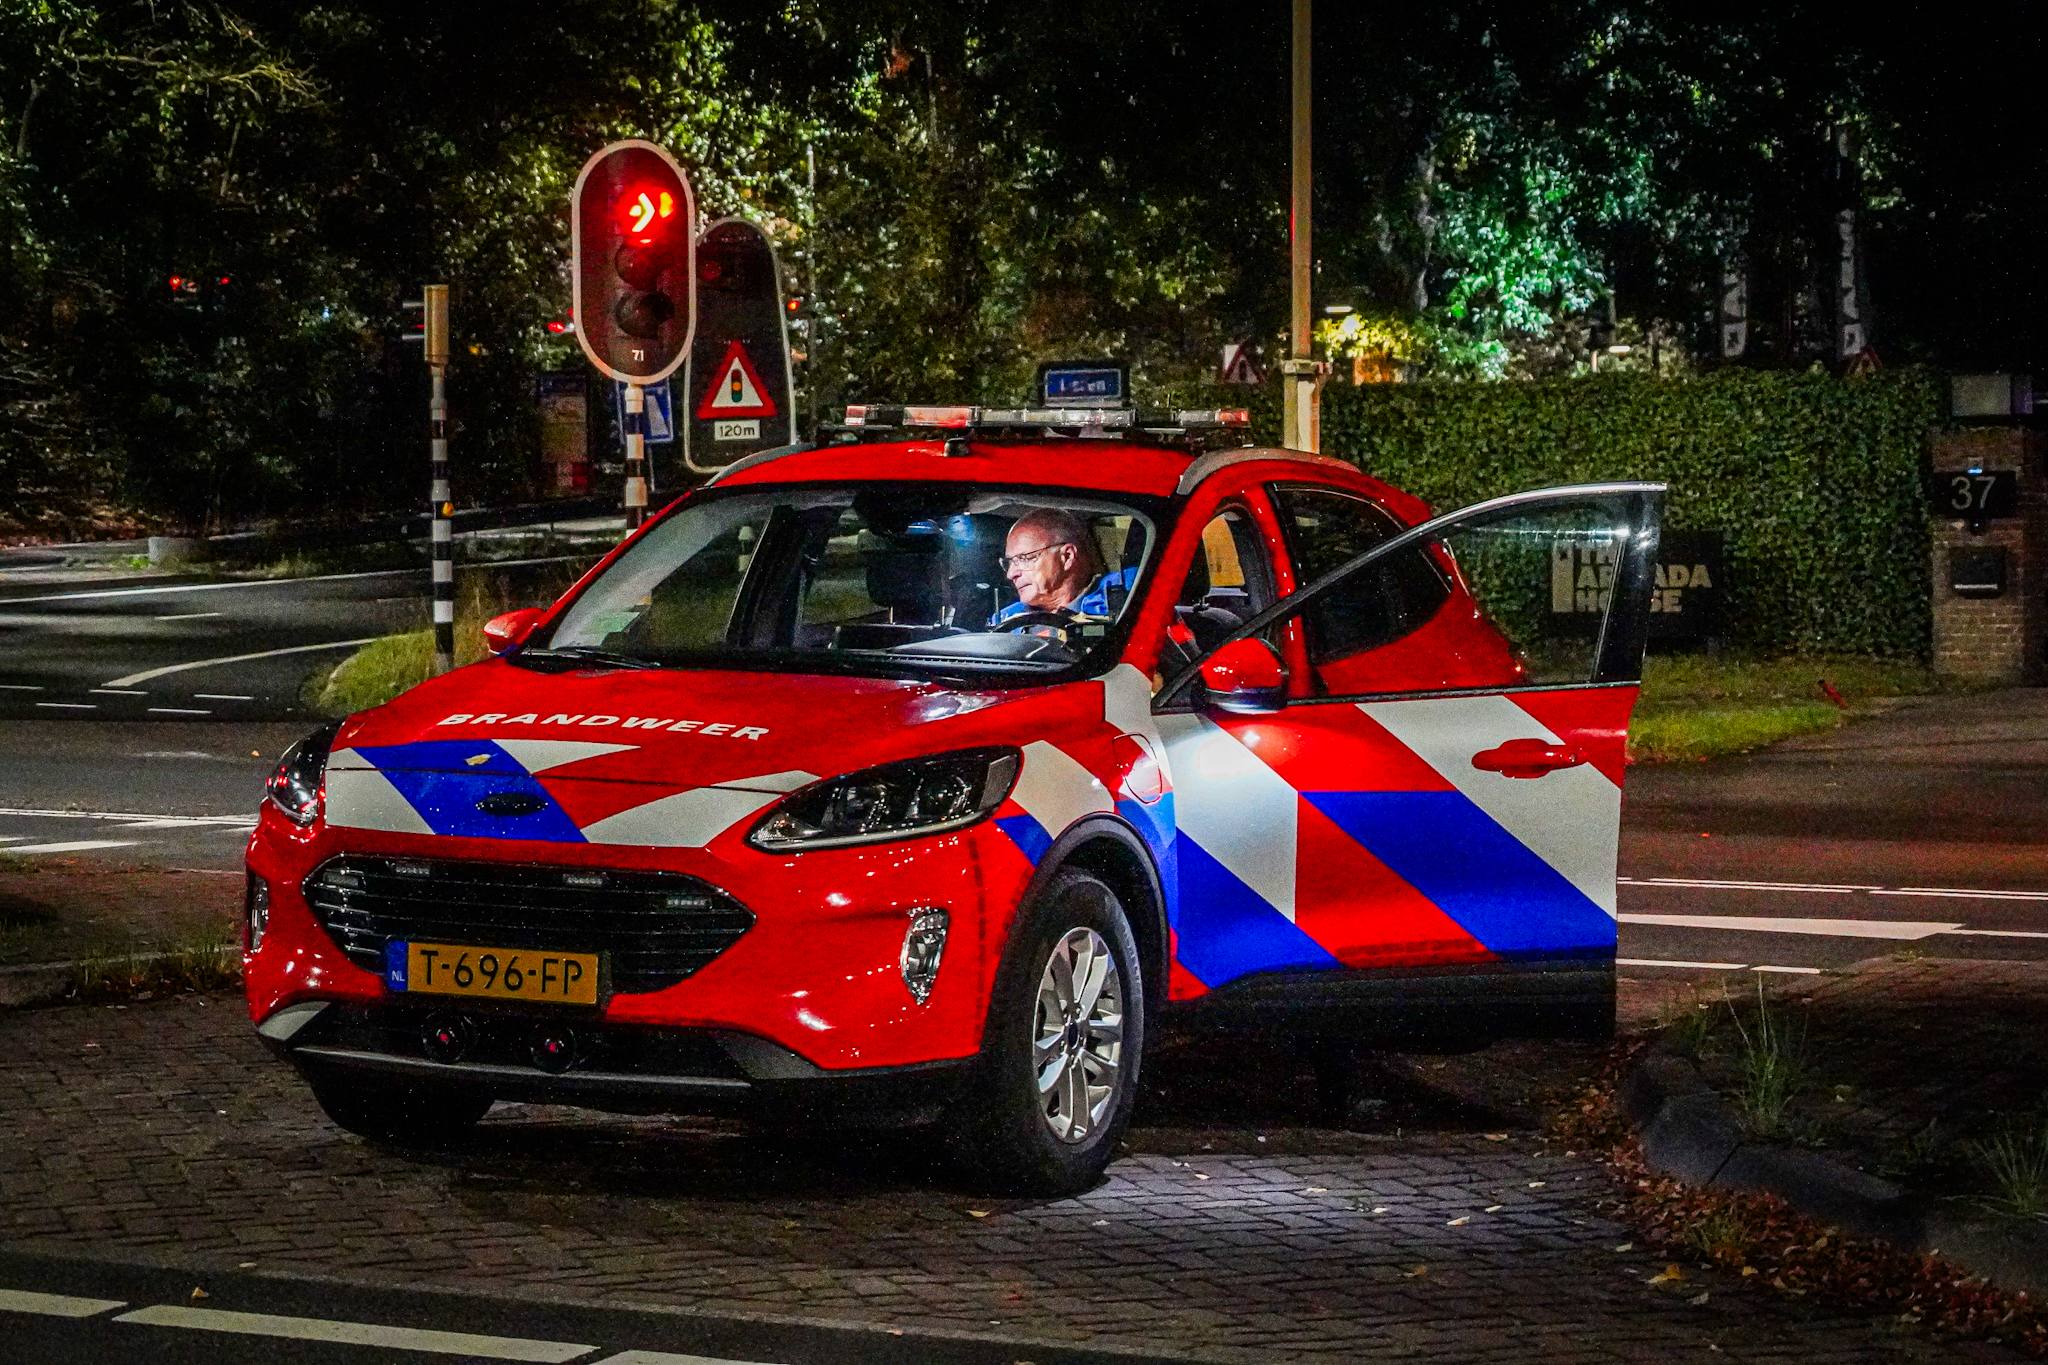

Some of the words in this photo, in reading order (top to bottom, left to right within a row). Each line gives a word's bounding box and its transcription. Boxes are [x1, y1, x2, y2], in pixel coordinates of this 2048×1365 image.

[631, 349, 644, 361] 71
[720, 424, 755, 437] 120m
[1951, 475, 1996, 510] 37
[1576, 564, 1713, 588] ARADA
[1575, 589, 1682, 613] HOSE
[436, 713, 770, 741] BRANDWEER
[391, 970, 405, 982] NL
[420, 950, 583, 994] T-696-FP
